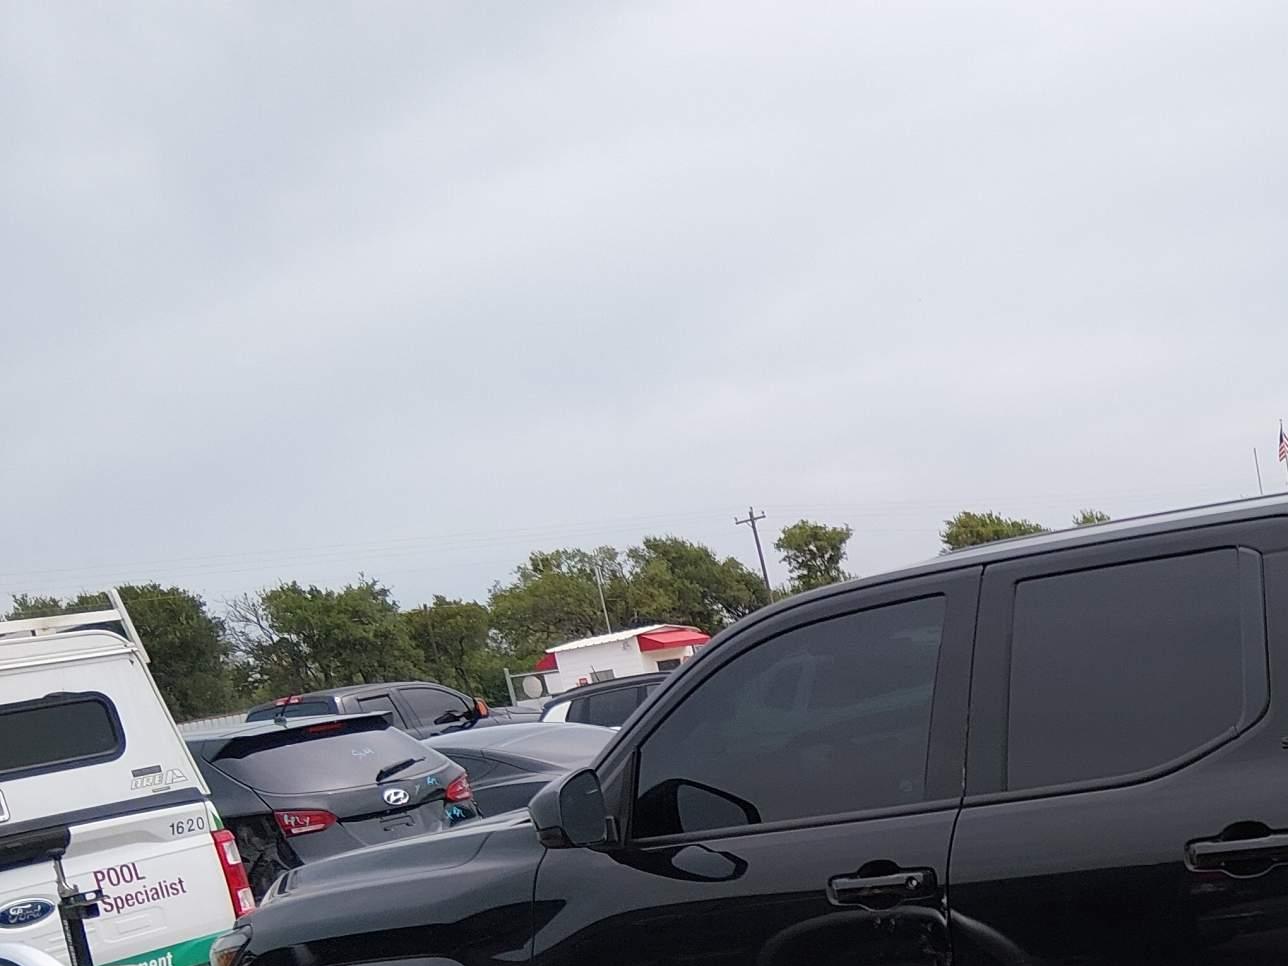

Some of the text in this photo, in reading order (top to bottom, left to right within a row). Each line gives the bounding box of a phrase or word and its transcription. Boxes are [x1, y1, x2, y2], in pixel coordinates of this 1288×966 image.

[169, 815, 206, 837] 1620
[92, 862, 146, 890] POOL
[101, 876, 188, 914] Specialist
[8, 903, 43, 924] Ford
